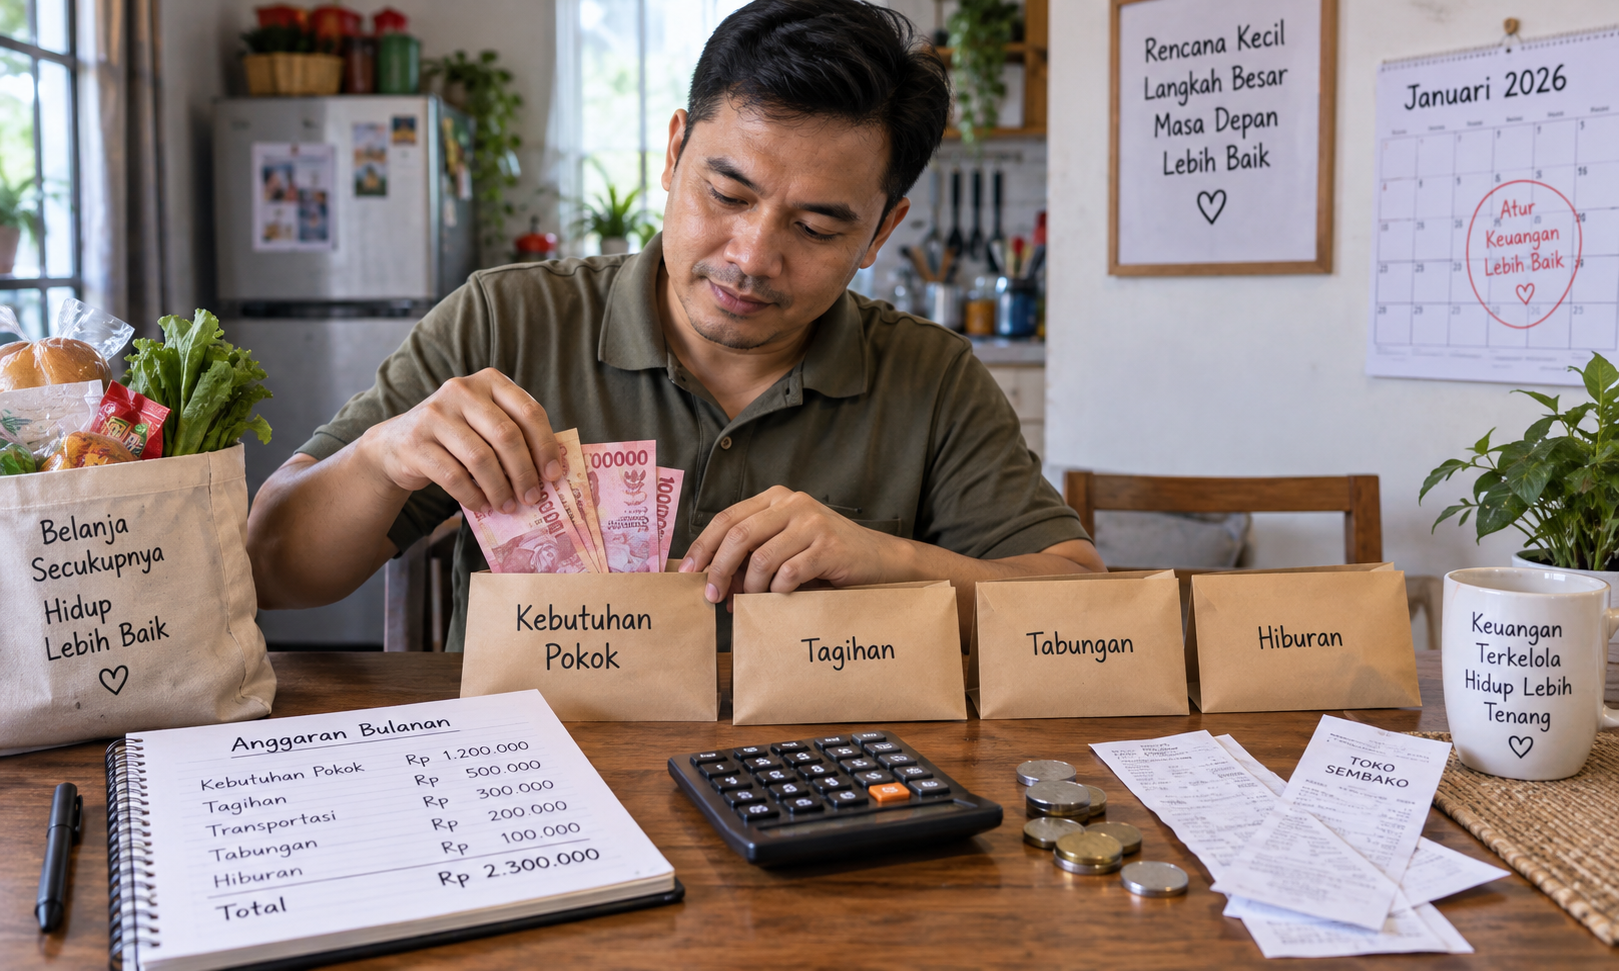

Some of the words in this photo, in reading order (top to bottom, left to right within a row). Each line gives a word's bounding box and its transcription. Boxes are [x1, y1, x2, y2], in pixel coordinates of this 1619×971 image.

[1145, 37, 1227, 63] Rencana
[1237, 18, 1285, 51] Kecil
[1144, 68, 1223, 107] Langkah
[1231, 65, 1288, 91] Besar
[1404, 76, 1490, 111] Januari
[1504, 63, 1567, 98] 2026
[1154, 112, 1205, 138] Masa
[1214, 106, 1278, 140] Depan
[1163, 146, 1216, 176] Lebih
[1226, 142, 1271, 171] Baik
[1499, 199, 1535, 220] Atur
[1485, 228, 1560, 251] Keuangan
[1484, 254, 1525, 277] Lebih
[1530, 250, 1565, 272] Baik
[39, 513, 129, 546] Belanja
[31, 546, 165, 582] Secukupnya
[44, 593, 112, 625] Hidup
[517, 603, 652, 632] Kebutuhan
[44, 627, 110, 662] Lebih
[118, 615, 170, 648] Baik
[1258, 624, 1343, 650] Hiburan
[1472, 611, 1563, 647] Keuangan
[545, 642, 620, 671] Pokok
[800, 635, 895, 671] Tagihan
[1025, 630, 1134, 664] Tabungan
[1475, 642, 1562, 668] Terkelola
[1465, 668, 1514, 703] Hidup
[1523, 675, 1572, 697] Lebih
[1483, 701, 1551, 733] Tenang
[231, 730, 347, 754] Anggaran
[358, 719, 451, 737] Bulanan
[200, 771, 305, 791] Kebutuhan
[312, 762, 365, 777] Pokok
[405, 754, 430, 768] Rp
[443, 741, 529, 761] 1.200.000
[1325, 764, 1409, 788] SEMBAKO
[1350, 755, 1396, 773] TOKO
[202, 796, 287, 816] Tagihan
[414, 774, 439, 788] Rp
[465, 760, 541, 778] 500.000
[204, 810, 337, 838] Transportasi
[422, 795, 449, 810] Rp
[476, 780, 554, 799] 300.000
[208, 840, 318, 863] Tabungan
[431, 818, 458, 833] Rp
[488, 800, 567, 822] 200.000
[213, 868, 303, 888] Hiburan
[441, 841, 469, 856] Rp
[501, 822, 581, 844] 100.000
[215, 896, 287, 922] Total
[437, 871, 470, 888] Rp
[483, 848, 600, 879] 2.300.000
